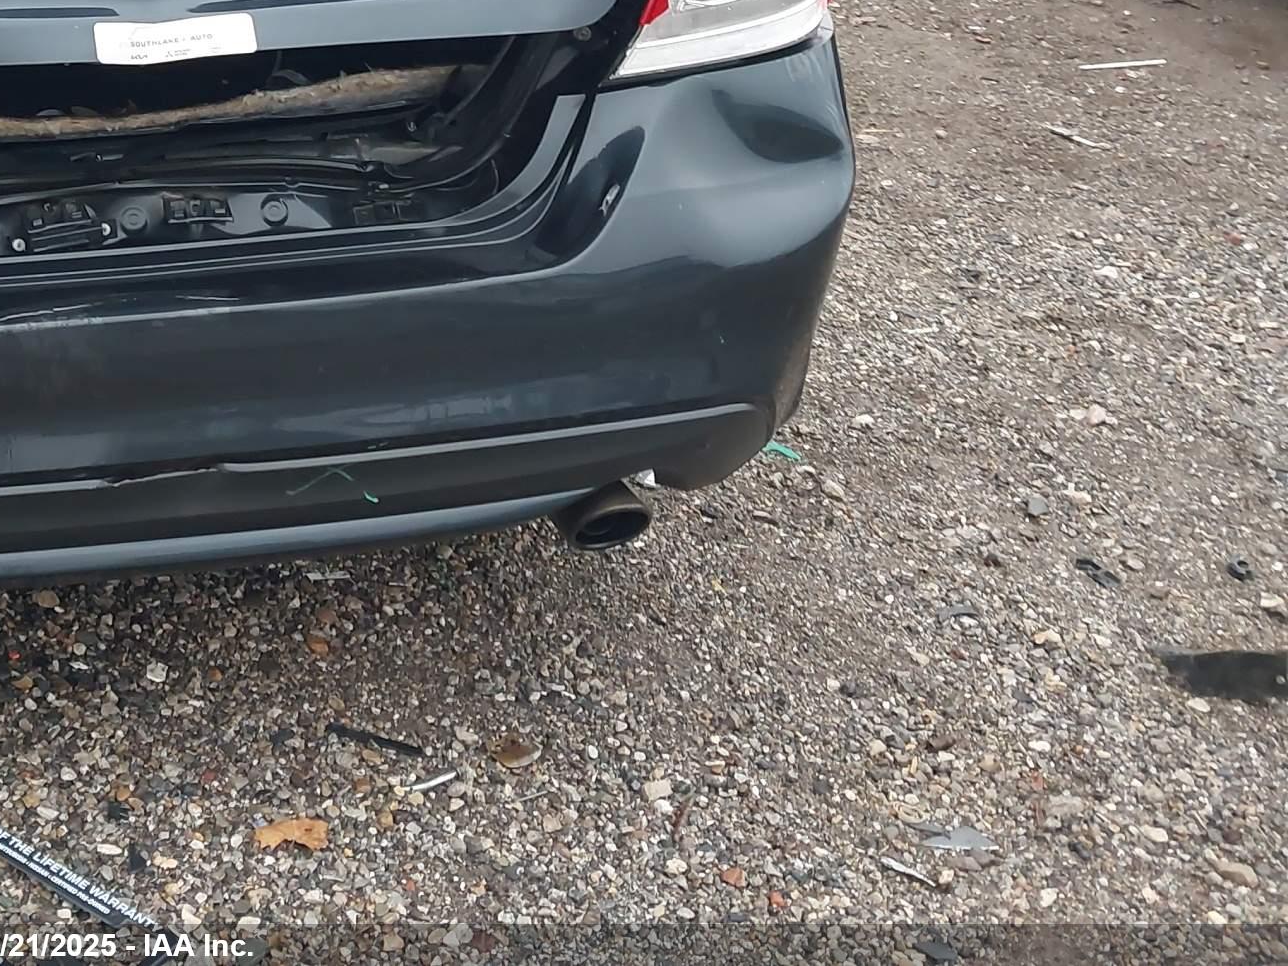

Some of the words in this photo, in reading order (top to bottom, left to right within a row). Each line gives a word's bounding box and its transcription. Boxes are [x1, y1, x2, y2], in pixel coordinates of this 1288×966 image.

[190, 33, 214, 41] AUTO
[8, 836, 35, 857] THE
[32, 853, 90, 890] LIFETIME
[89, 885, 163, 931] WARRANTY
